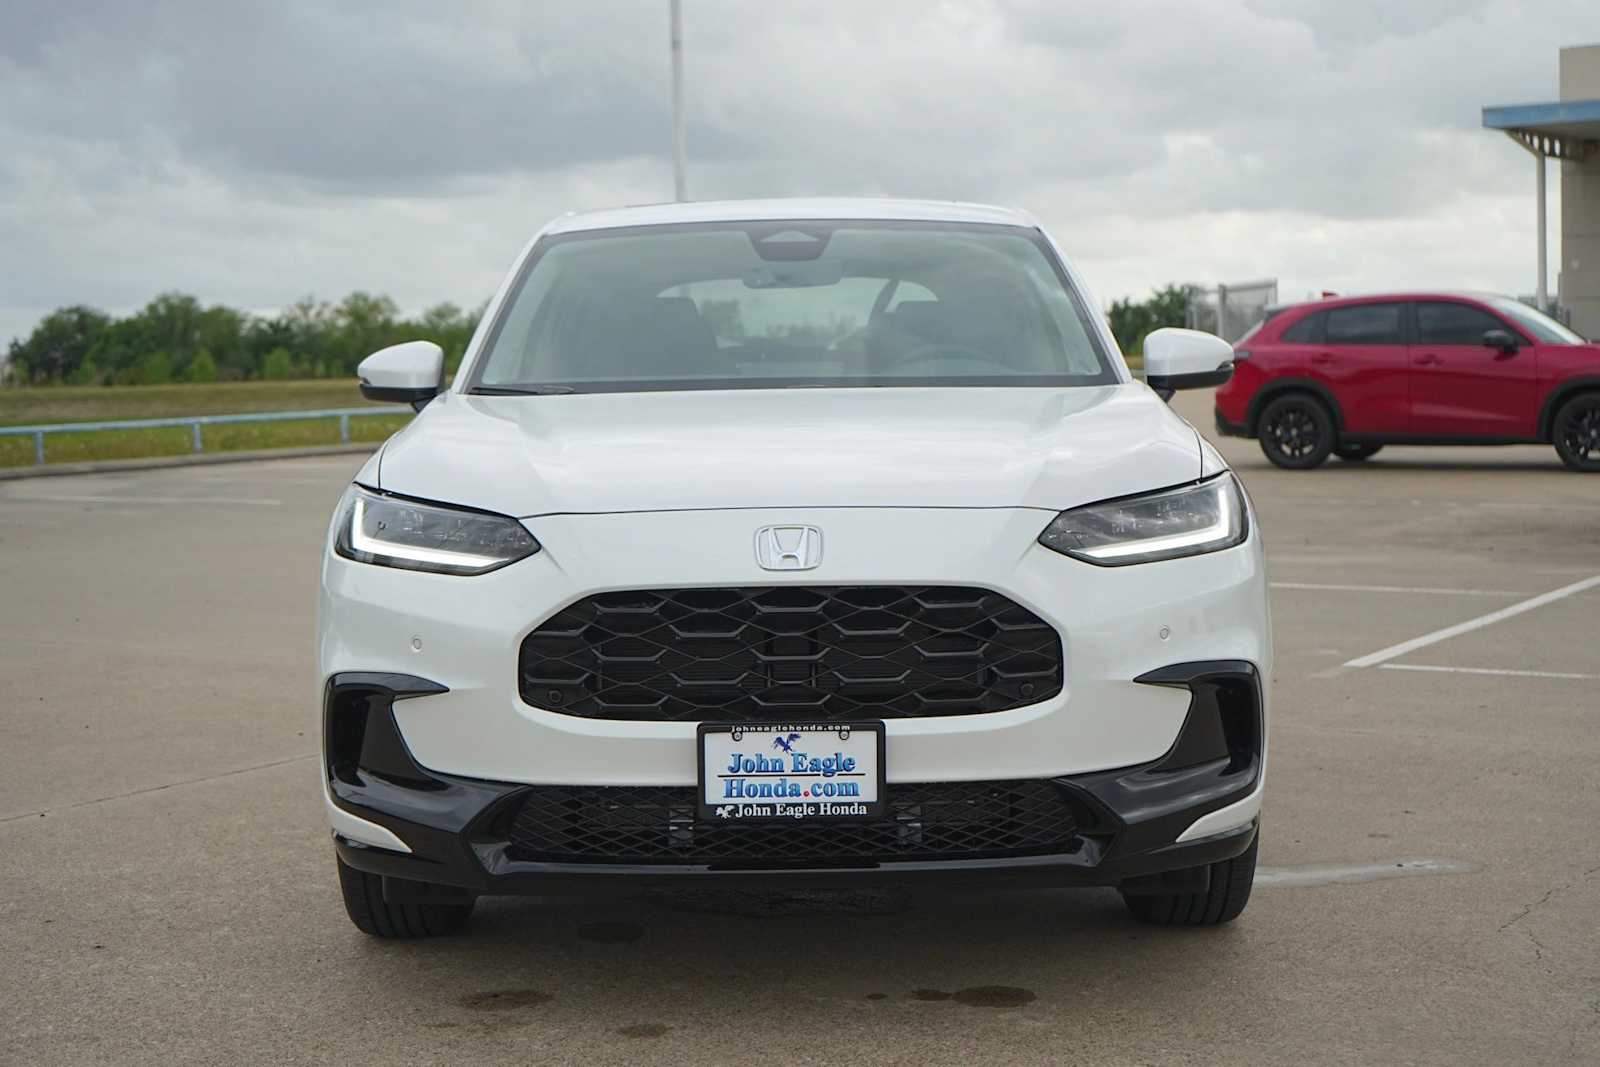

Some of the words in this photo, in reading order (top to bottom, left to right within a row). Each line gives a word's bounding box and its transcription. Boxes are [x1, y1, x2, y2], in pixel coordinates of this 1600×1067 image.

[727, 752, 785, 773] John
[791, 752, 856, 777] Eagle
[723, 778, 860, 799] Honda.com
[735, 804, 771, 817] John
[776, 803, 816, 818] Eagle
[819, 802, 867, 816] Honda
